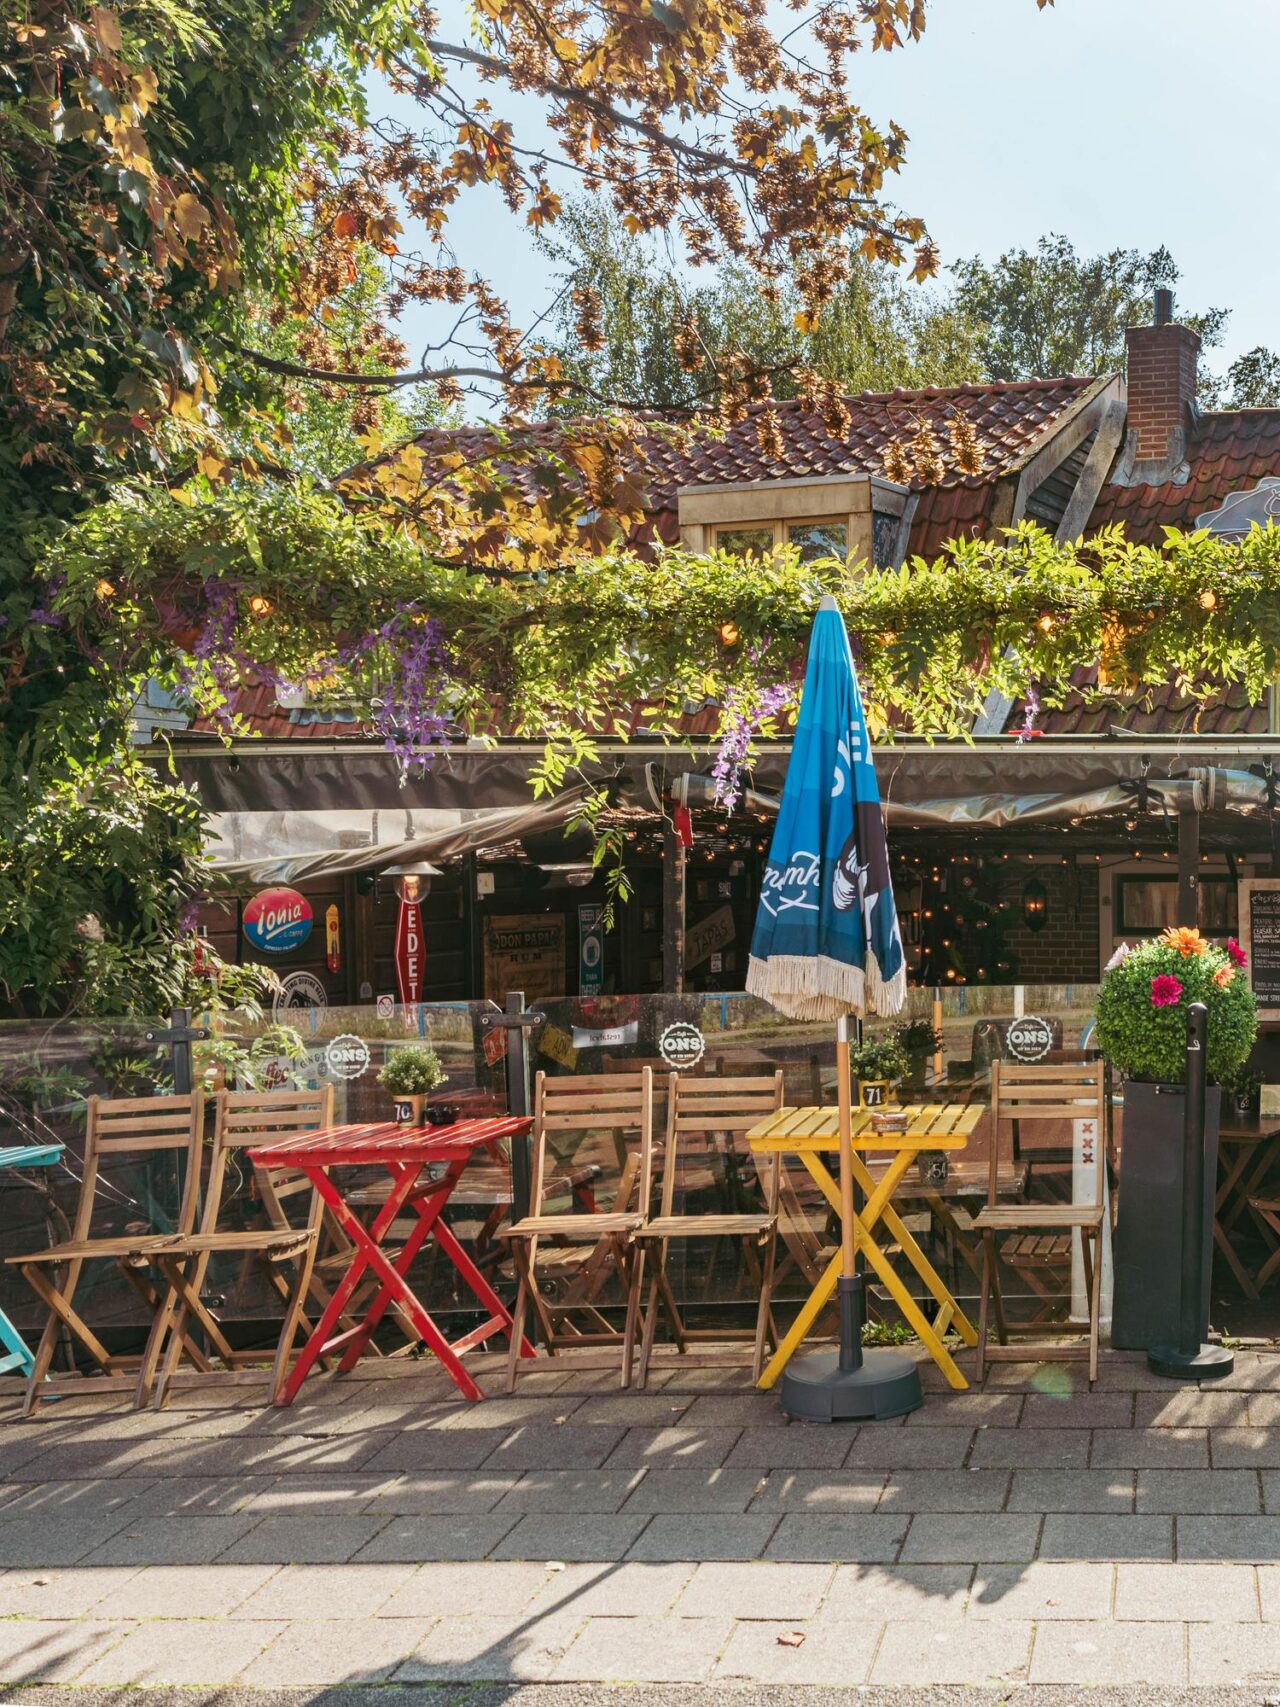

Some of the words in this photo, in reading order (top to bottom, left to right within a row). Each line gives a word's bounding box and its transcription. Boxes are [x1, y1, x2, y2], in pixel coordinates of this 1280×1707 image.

[664, 1038, 700, 1050] ONS
[1011, 1031, 1048, 1043] ONS
[329, 1048, 366, 1062] ONS
[866, 1087, 882, 1104] 71
[395, 1104, 410, 1121] 70
